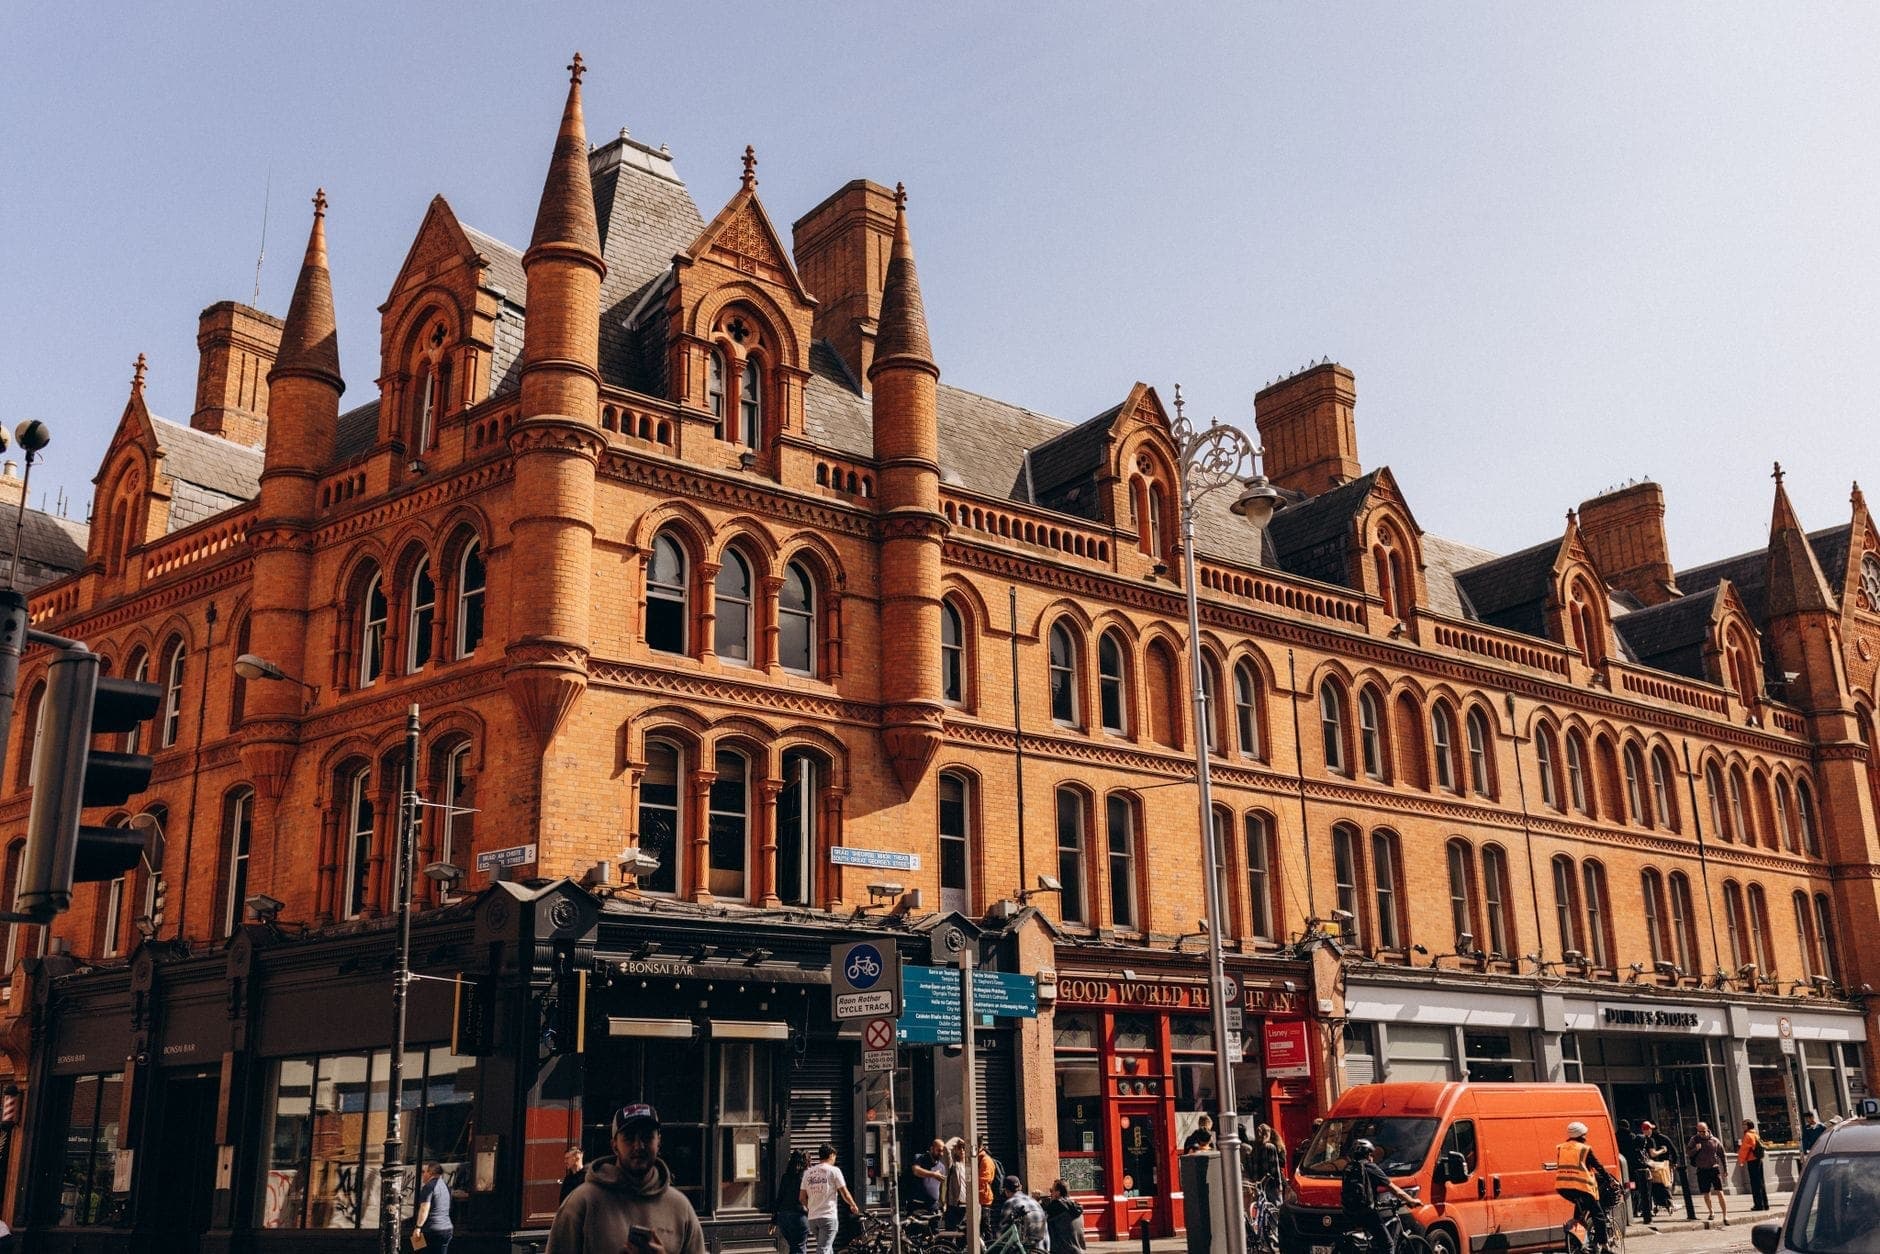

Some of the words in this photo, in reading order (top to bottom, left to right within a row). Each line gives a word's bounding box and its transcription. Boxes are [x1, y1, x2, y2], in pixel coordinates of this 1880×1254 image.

[528, 849, 533, 858] 2
[629, 962, 670, 974] BONSAI
[673, 965, 694, 976] BAR
[838, 997, 856, 1005] Raon
[858, 995, 882, 1003] Rothar
[1059, 979, 1111, 1000] GOOD
[1118, 982, 1184, 1005] WORLD
[1191, 986, 1299, 1011] REURANT
[839, 1005, 863, 1014] CYCLE
[865, 1002, 890, 1012] TRACK
[1655, 1010, 1698, 1027] STORES
[1268, 1029, 1288, 1038] Lisney
[184, 1043, 196, 1052] BAR
[1864, 1100, 1878, 1114] D
